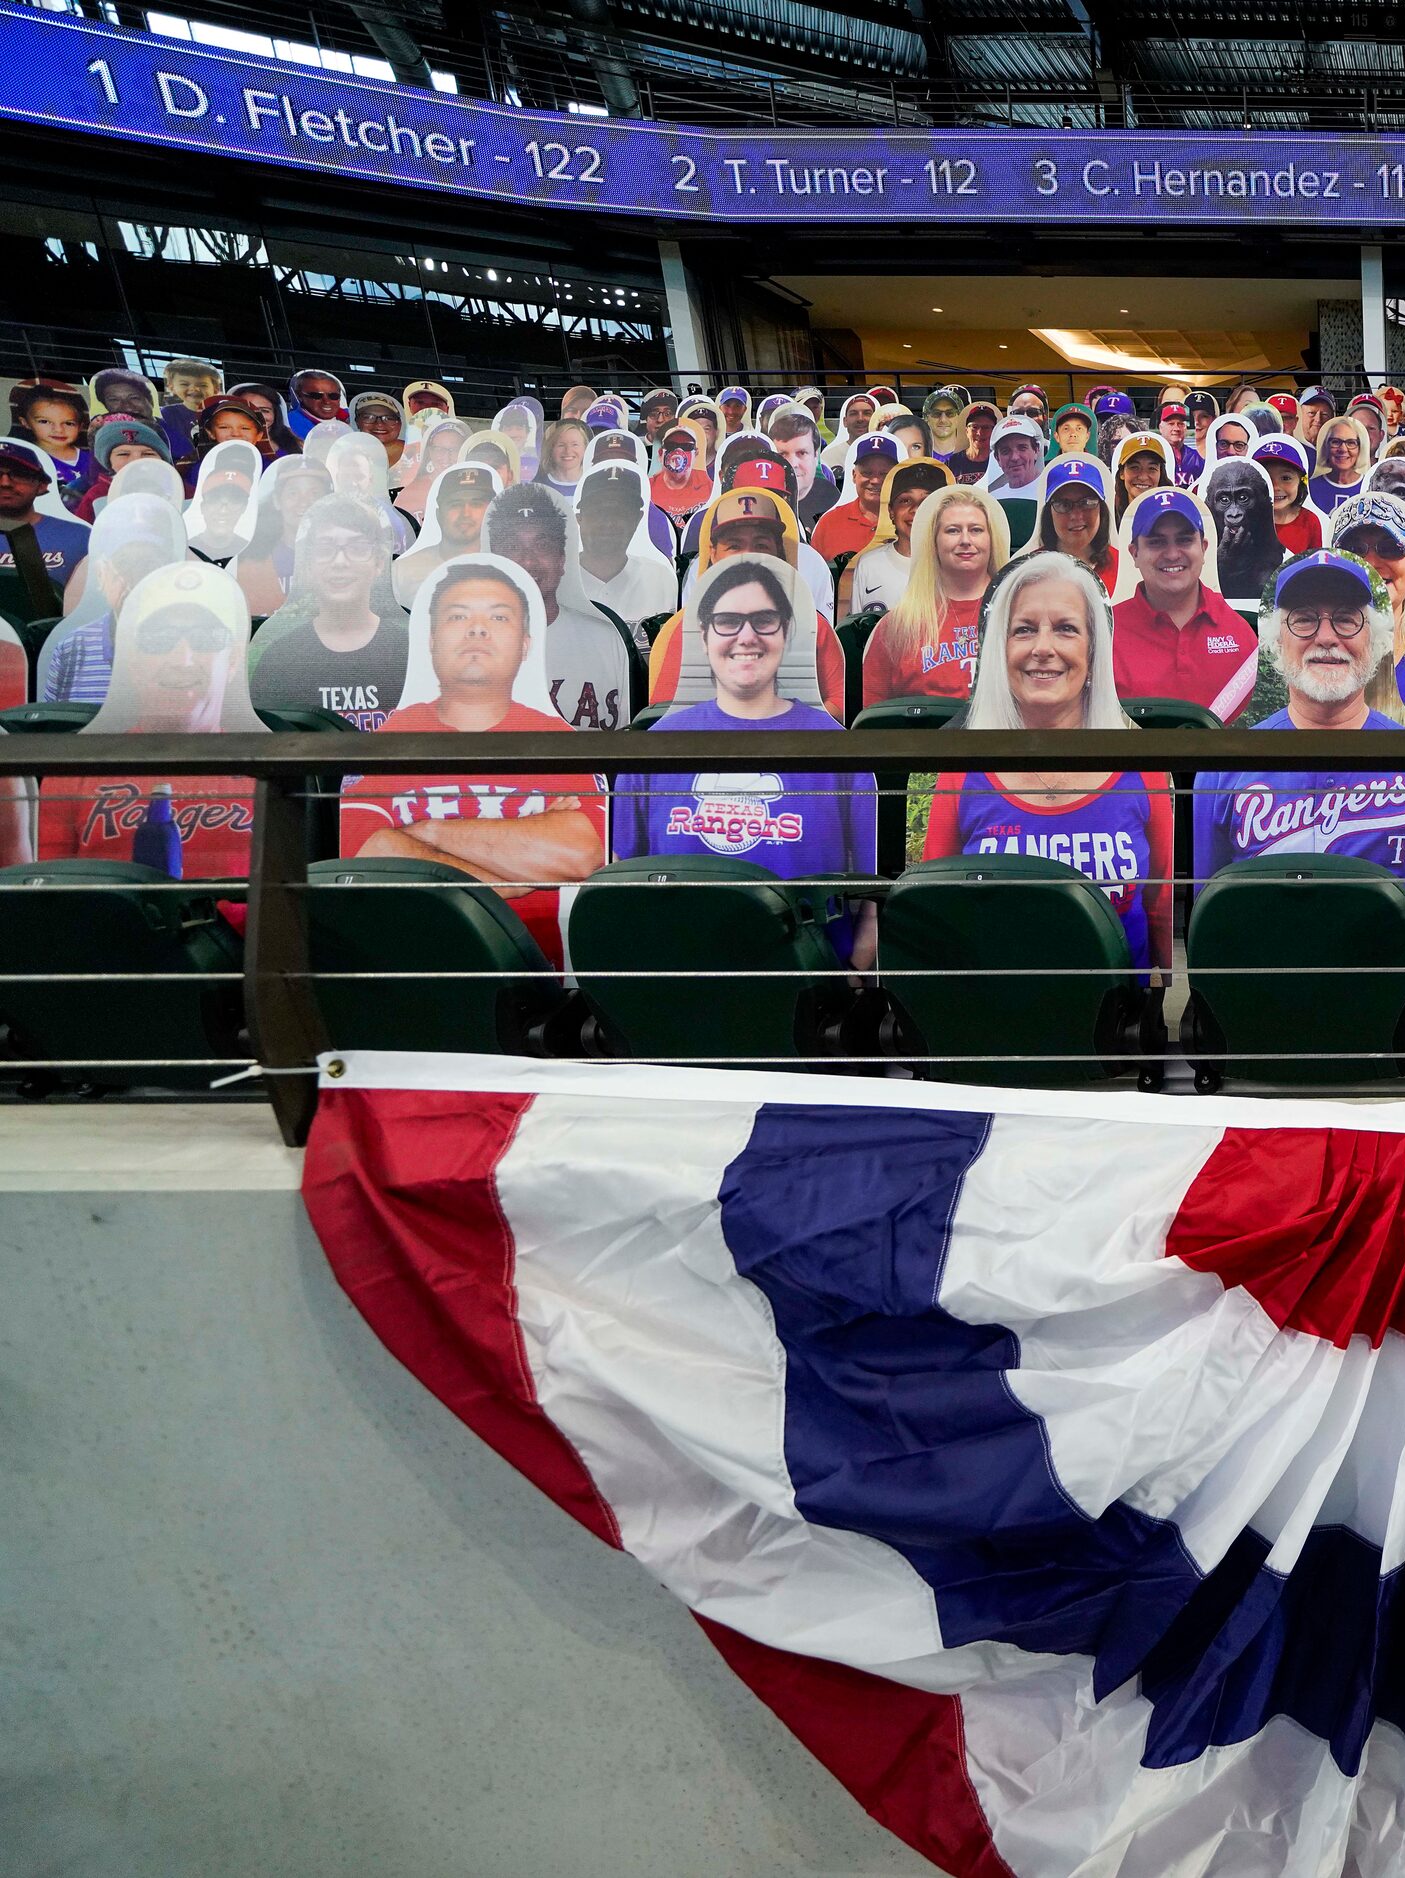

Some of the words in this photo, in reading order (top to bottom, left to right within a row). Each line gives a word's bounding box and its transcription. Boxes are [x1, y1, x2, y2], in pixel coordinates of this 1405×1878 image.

[88, 58, 119, 105] 1
[155, 71, 226, 123] D.
[242, 88, 474, 167] Fletcher
[525, 141, 604, 184] 122
[671, 155, 698, 192] 2
[723, 160, 757, 197] T.
[769, 160, 889, 197] Turner
[924, 160, 978, 197] 112
[1035, 161, 1058, 197] 3
[1082, 161, 1120, 197] C.
[1133, 161, 1341, 200] Hernandez
[1107, 397, 1120, 407] T
[869, 437, 884, 449] T
[755, 462, 773, 479] T
[1063, 461, 1084, 475] T
[738, 496, 757, 516] T
[1154, 492, 1175, 506] T
[319, 685, 379, 710] TEXAS
[82, 783, 252, 845] Rager
[704, 802, 764, 816] TEXAS
[986, 825, 1021, 836] TEXAS
